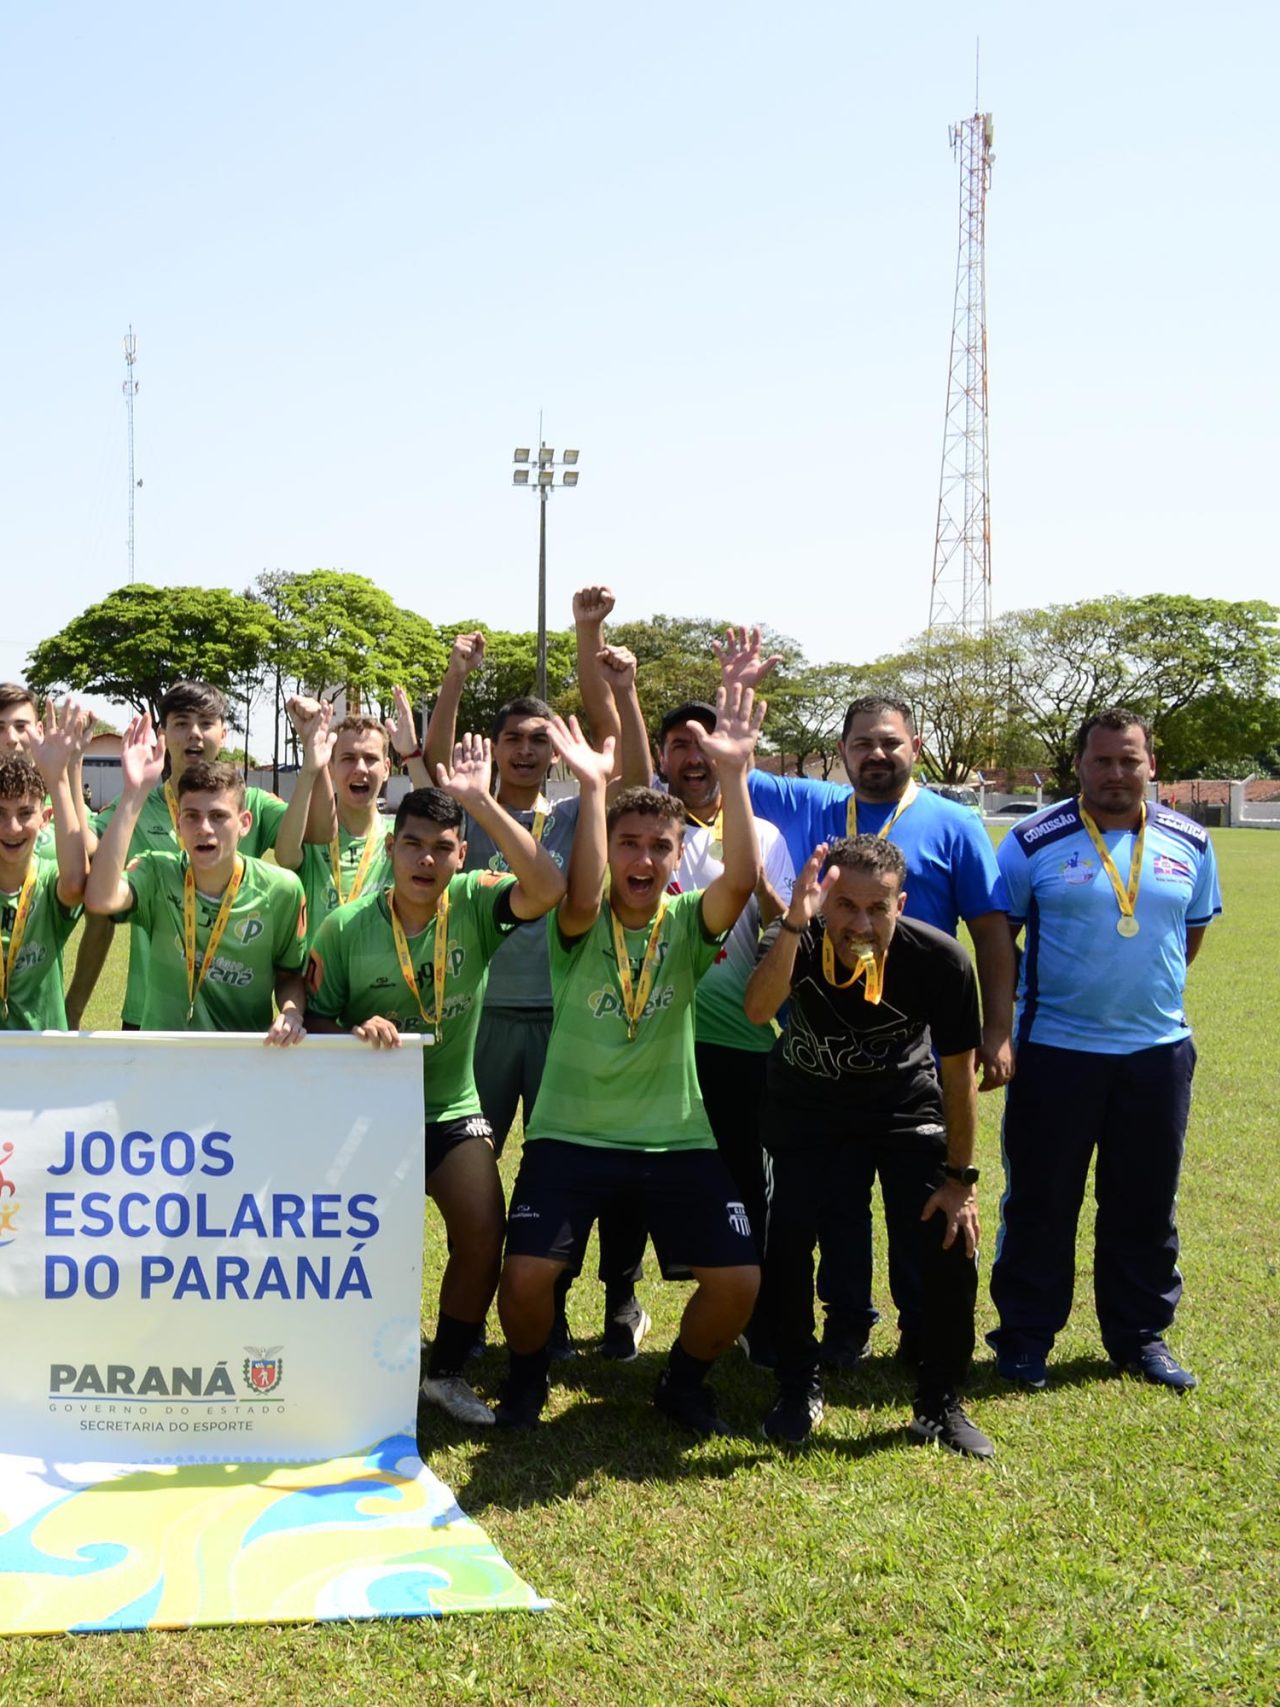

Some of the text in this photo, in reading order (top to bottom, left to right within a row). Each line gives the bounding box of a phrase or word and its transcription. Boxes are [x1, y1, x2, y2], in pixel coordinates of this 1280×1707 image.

[1023, 813, 1077, 843] COMISSÃO
[1157, 812, 1207, 842] TÉCNICA
[46, 1130, 236, 1177] JOGOS
[45, 1192, 380, 1239] ESCOLARES
[44, 1243, 373, 1300] DO PARANÁ
[49, 1361, 236, 1396] PARANÁ
[49, 1404, 286, 1416] GOVERNO DO ESTADO
[80, 1420, 254, 1433] SECRETARIA DO ESPORTE
